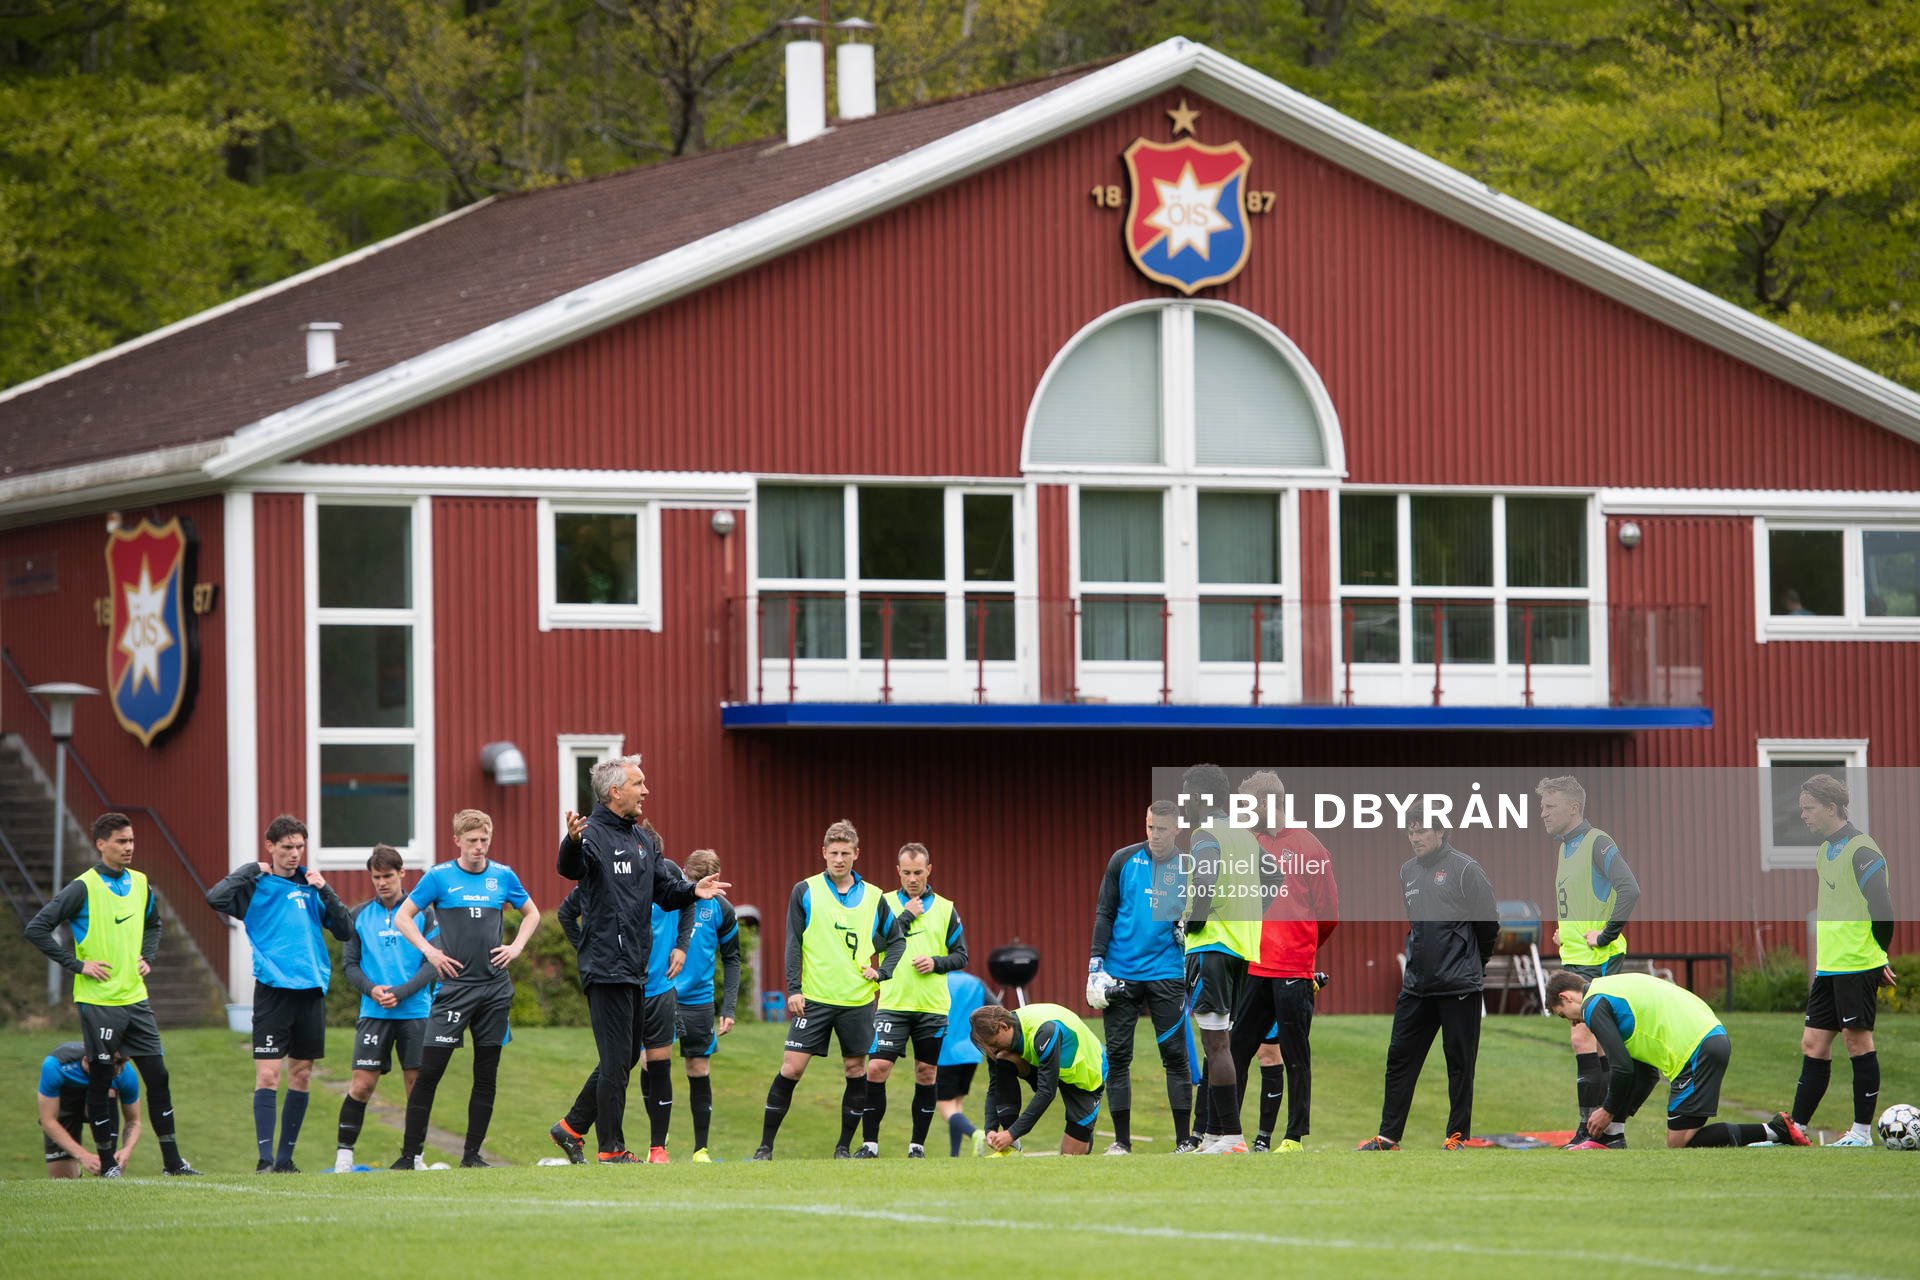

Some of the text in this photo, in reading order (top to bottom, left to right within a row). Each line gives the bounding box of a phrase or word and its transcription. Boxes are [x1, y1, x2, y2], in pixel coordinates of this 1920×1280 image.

[1091, 185, 1276, 213] 18 87
[192, 582, 213, 613] 87
[613, 861, 632, 874] KM
[468, 907, 482, 919] 13
[385, 936, 398, 947] 24
[845, 931, 859, 960] 9
[447, 1010, 461, 1023] 13
[794, 1017, 808, 1029] 18
[99, 1027, 113, 1040] 10
[875, 1022, 892, 1033] 20
[265, 1034, 274, 1047] 5
[363, 1033, 379, 1045] 24
